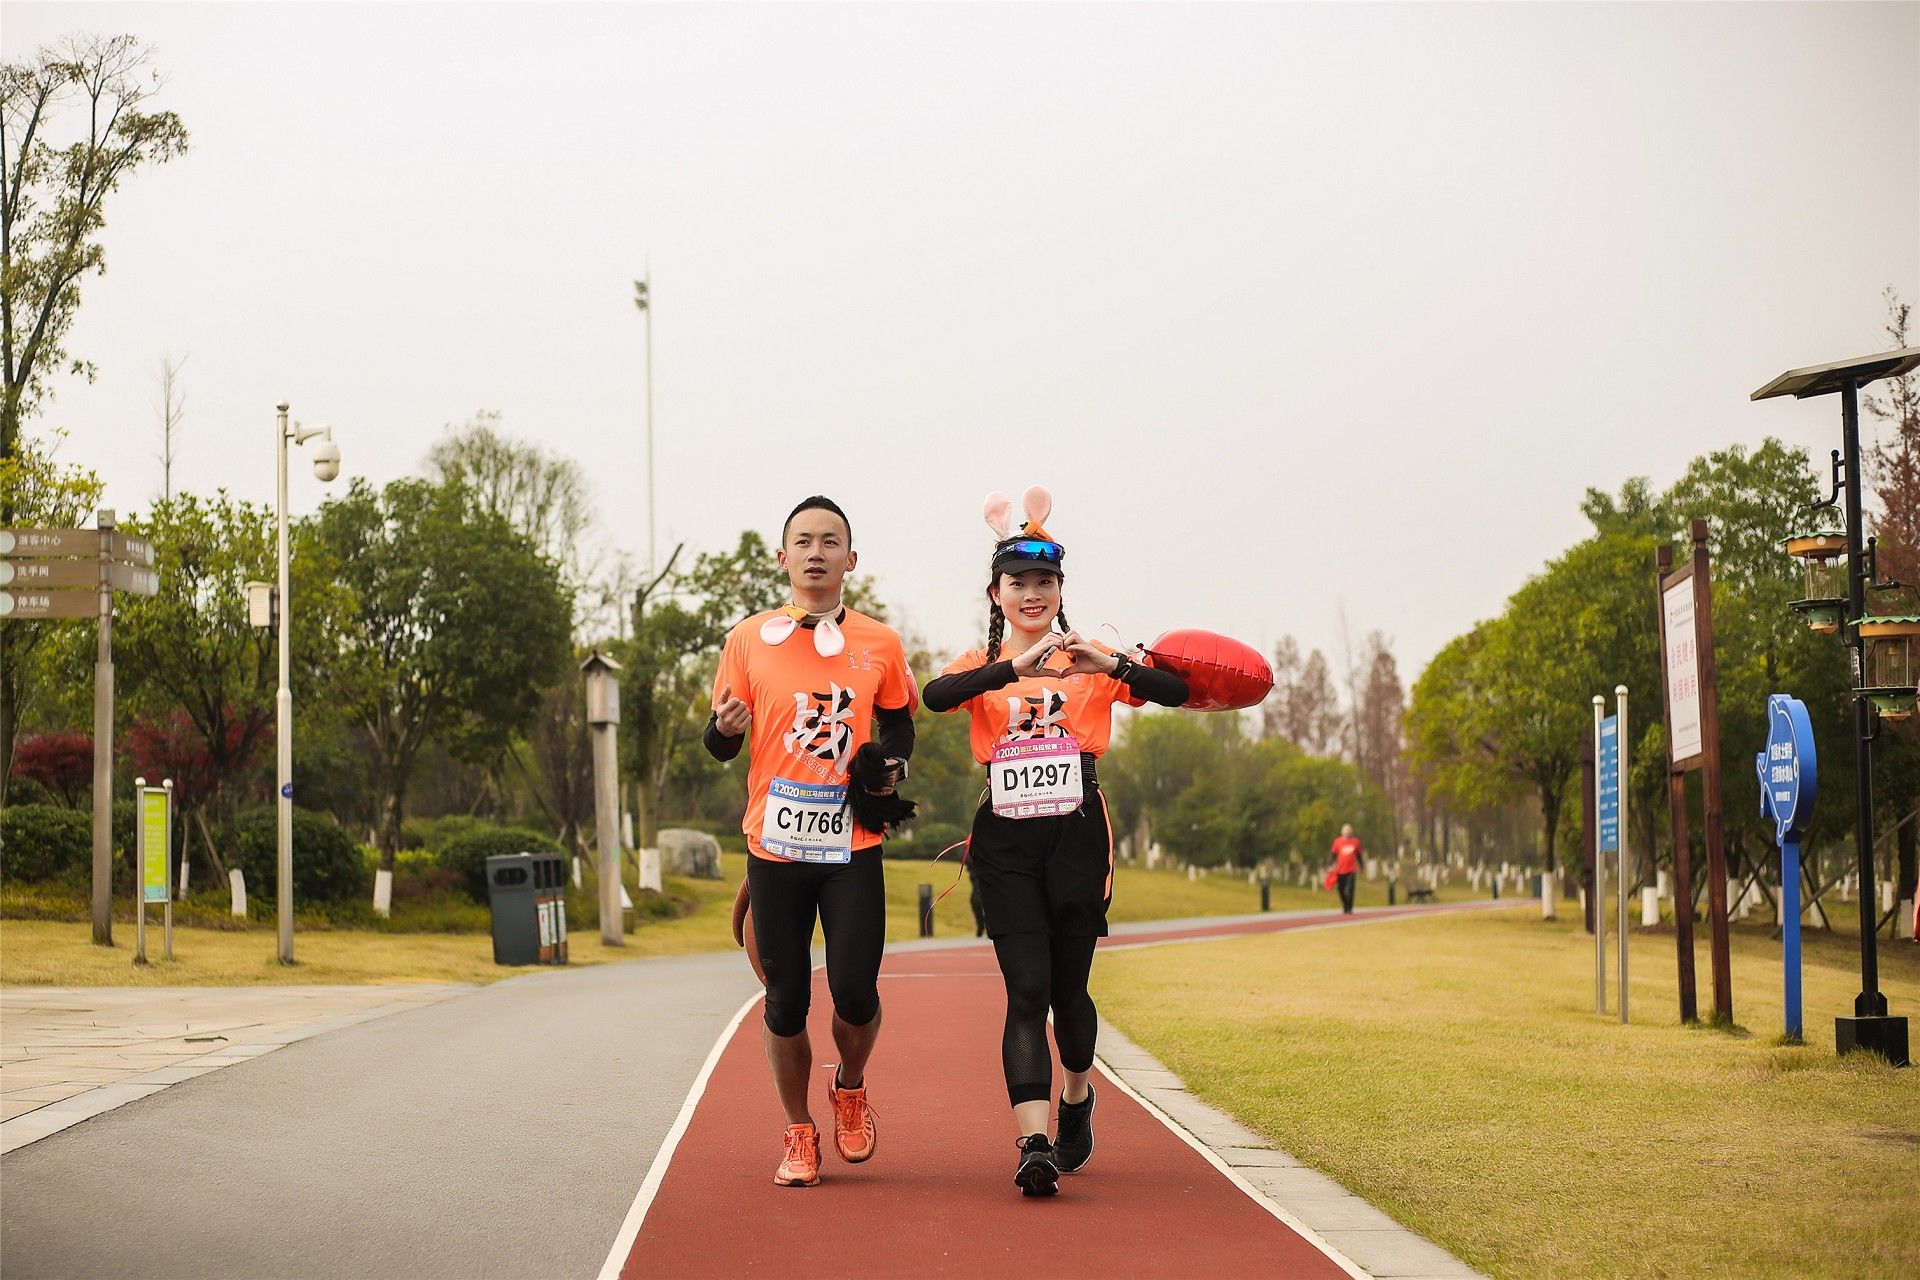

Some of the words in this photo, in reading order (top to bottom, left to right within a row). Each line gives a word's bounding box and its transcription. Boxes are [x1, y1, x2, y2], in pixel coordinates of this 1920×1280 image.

[17, 565, 49, 577] 洗手间
[18, 595, 50, 608] 停车场
[1003, 763, 1071, 792] D1297
[777, 806, 844, 835] C1766
